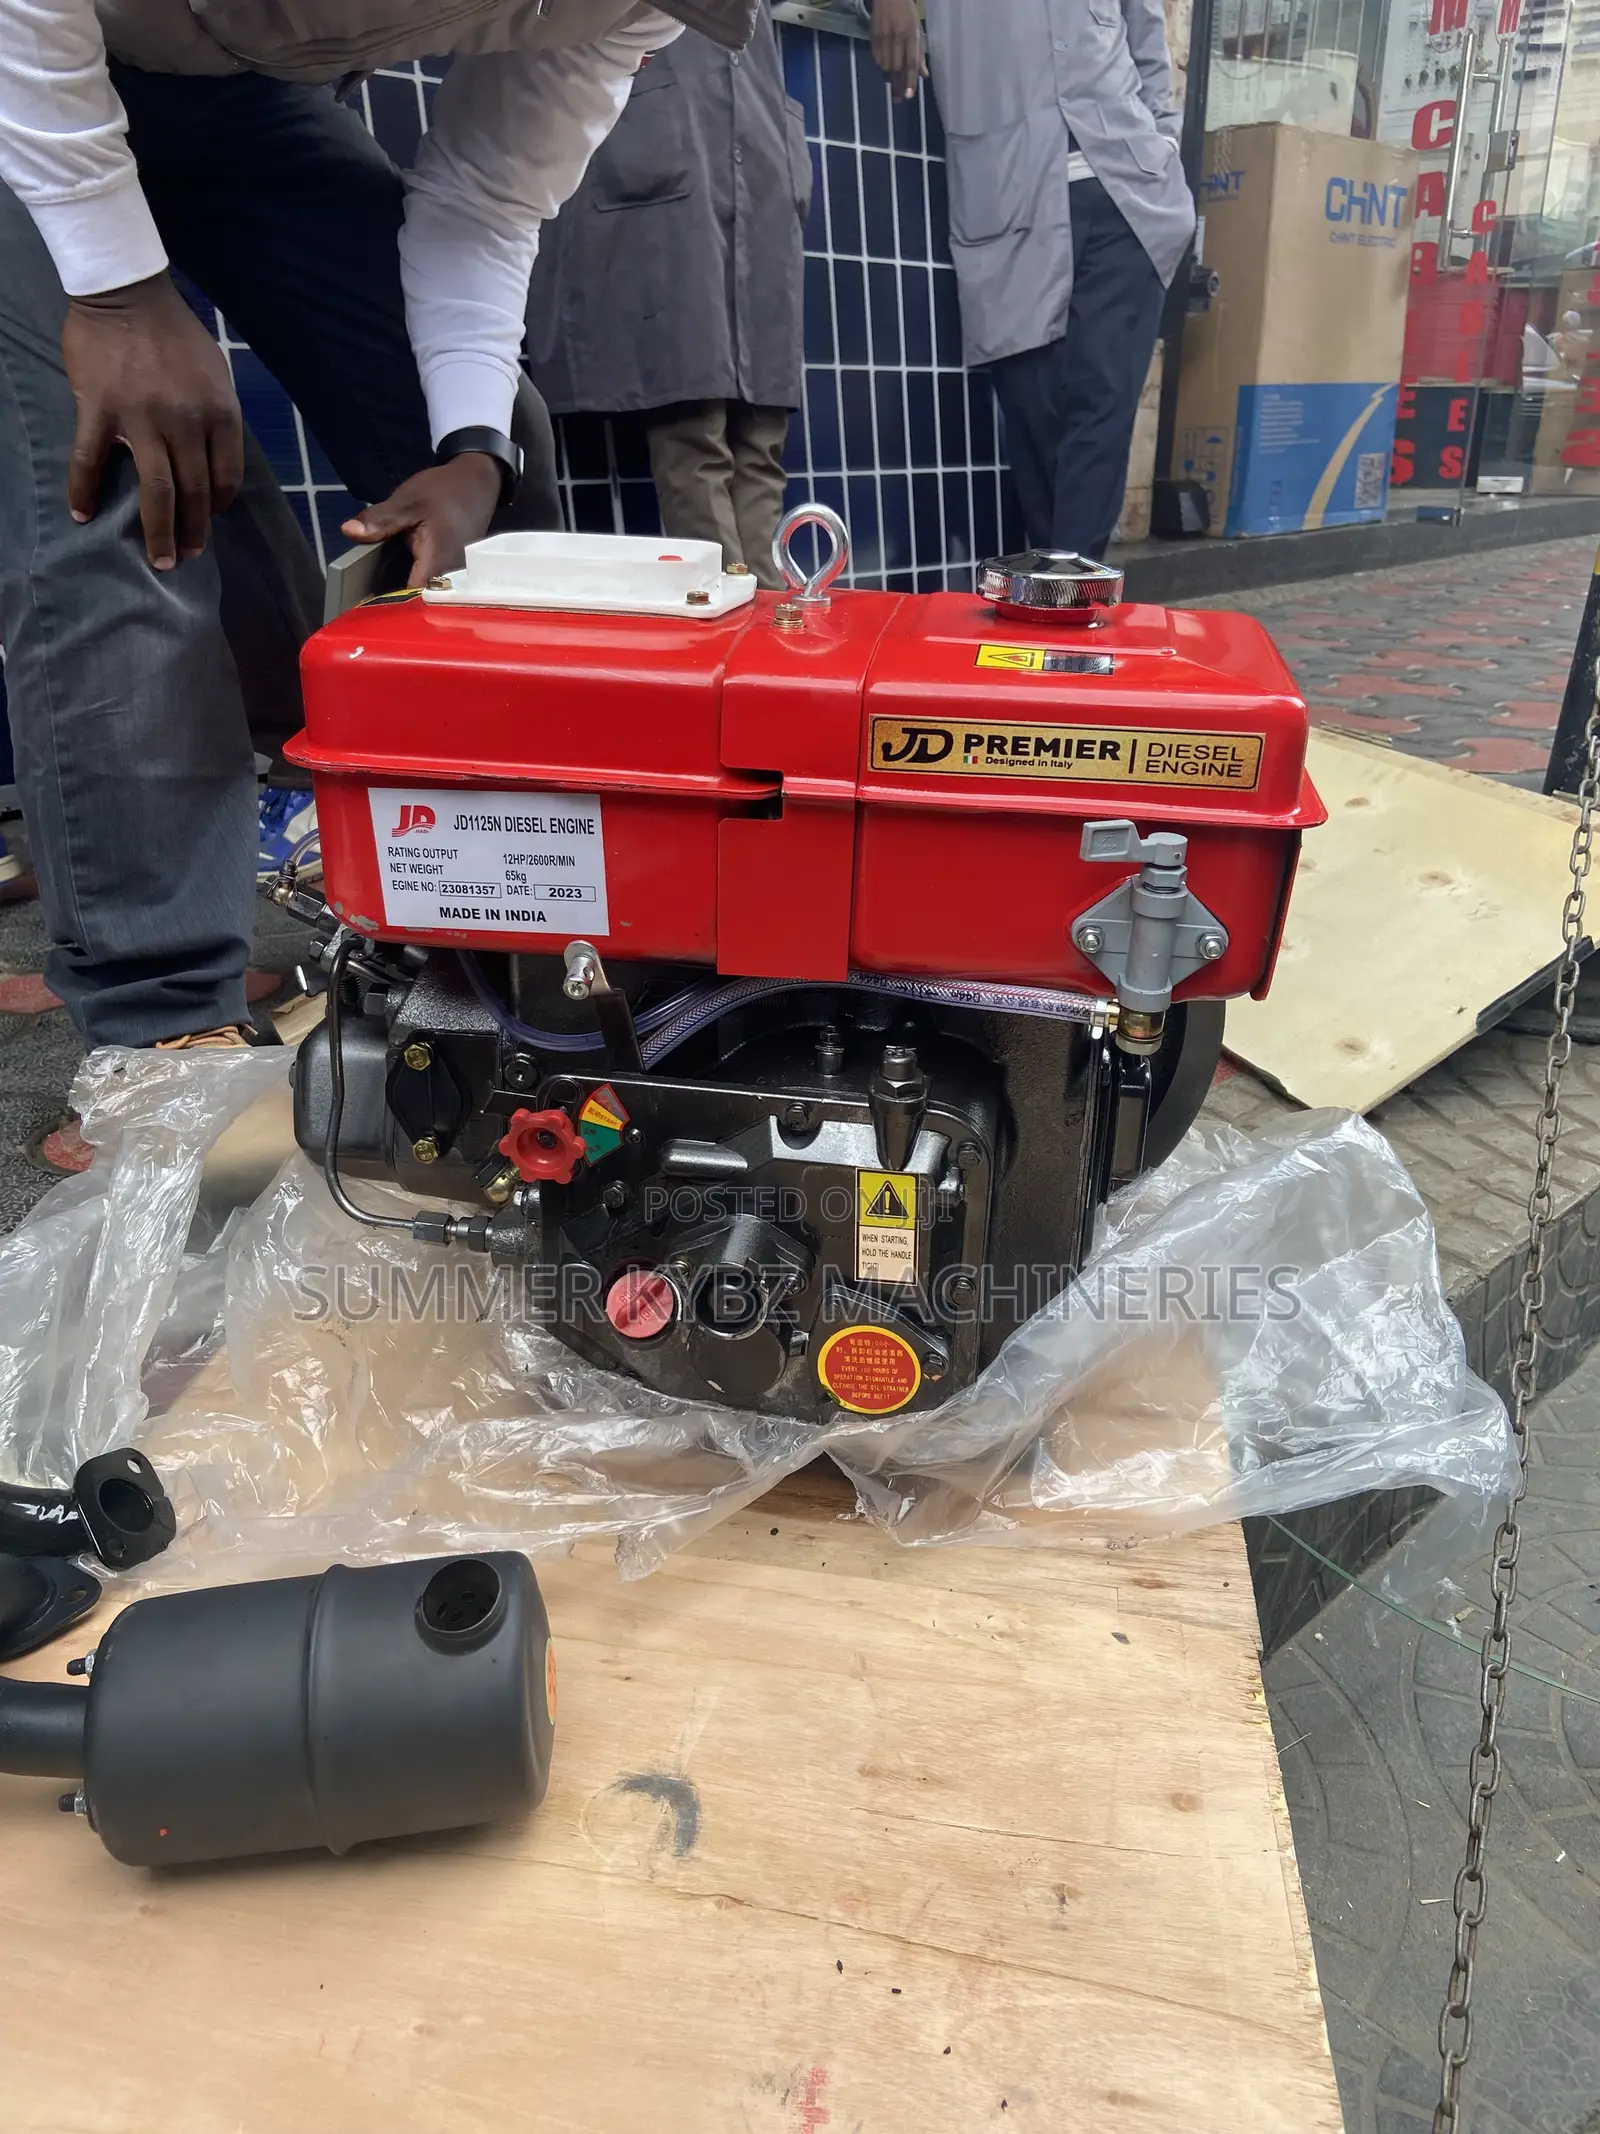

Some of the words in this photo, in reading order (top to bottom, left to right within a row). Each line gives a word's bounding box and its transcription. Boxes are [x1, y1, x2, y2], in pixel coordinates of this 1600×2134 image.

[882, 727, 954, 764] JD
[964, 733, 1121, 761] PREMIER
[1147, 742, 1245, 762] DIESEL
[985, 756, 1036, 767] Designed
[1050, 758, 1074, 769] Italy
[1145, 759, 1243, 778] ENGINE
[392, 804, 436, 838] JD
[454, 814, 502, 832] JD1125N
[505, 816, 547, 834] DIESEL
[550, 818, 595, 835] ENGINE
[388, 846, 420, 859] RATING
[422, 848, 458, 860] OUTPUT
[503, 853, 575, 867] 12HP/2600R/MIN
[390, 863, 408, 875] NET
[409, 864, 444, 876] WEIGHT
[505, 870, 527, 884] 65kg
[392, 880, 420, 892] EGINE
[421, 881, 437, 893] NO:
[441, 883, 496, 896] 23081357
[506, 885, 533, 897] DATE:
[548, 887, 582, 900] 2023
[439, 907, 481, 920] MADE
[485, 908, 501, 921] IN
[505, 909, 547, 923] INDIA
[862, 1233, 879, 1243] WHEN
[881, 1235, 909, 1246] STARTING,
[862, 1248, 877, 1257] HOLD
[879, 1249, 889, 1258] THE
[890, 1250, 912, 1260] HANDLE
[873, 1367, 890, 1375] HOURS
[832, 1382, 856, 1390] CLEANSE
[883, 1385, 909, 1393] STRAINER
